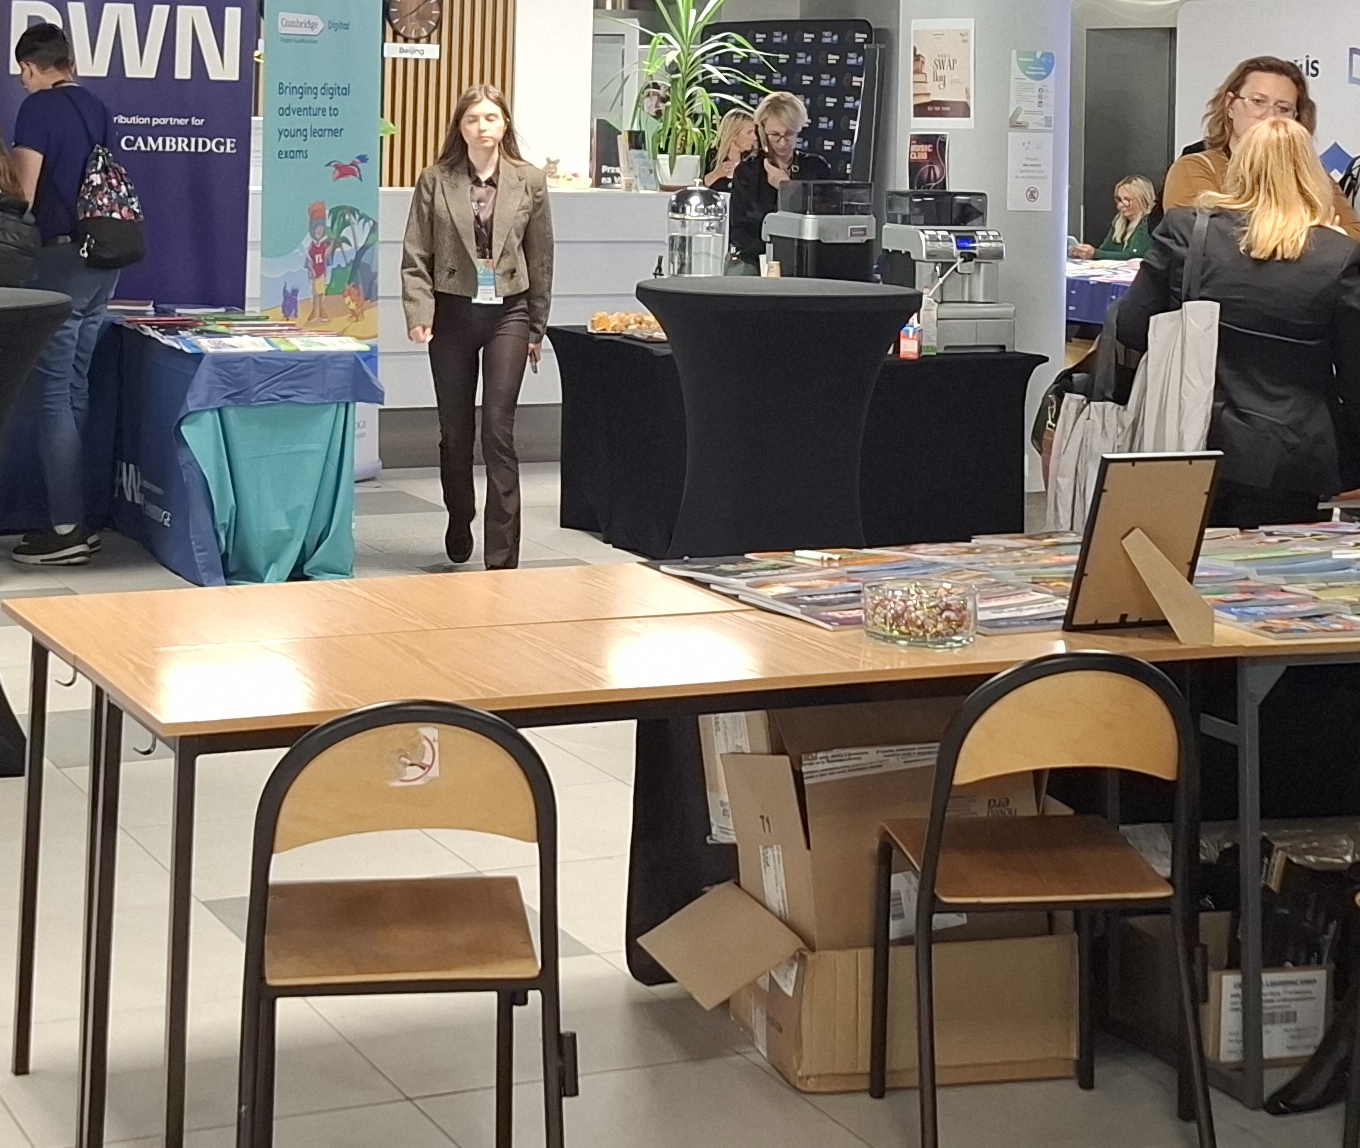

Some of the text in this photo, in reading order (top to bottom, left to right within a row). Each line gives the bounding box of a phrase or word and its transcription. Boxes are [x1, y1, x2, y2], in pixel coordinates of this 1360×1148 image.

[9, 0, 242, 81] PWN
[933, 58, 957, 71] SWAP
[278, 82, 351, 99] Bringing digital
[277, 103, 339, 117] adventure to
[113, 114, 205, 127] ribution partner for
[277, 124, 344, 142] young learner
[120, 135, 237, 153] CAMBRIDGE
[277, 149, 309, 160] exams
